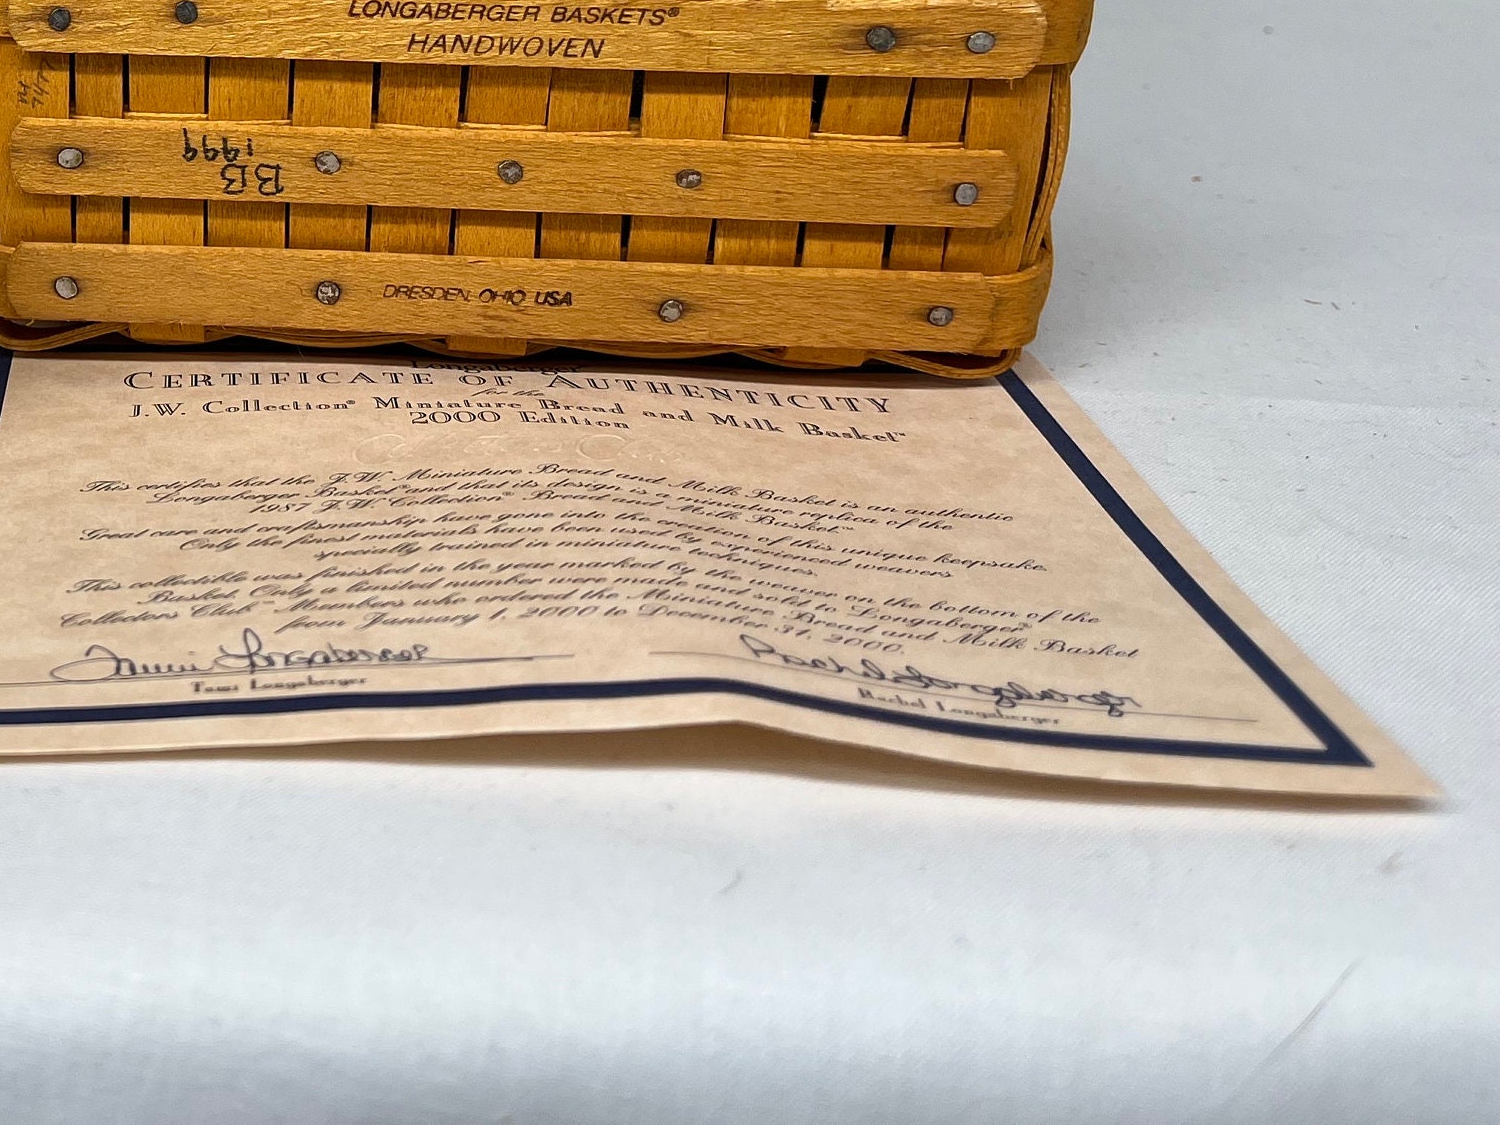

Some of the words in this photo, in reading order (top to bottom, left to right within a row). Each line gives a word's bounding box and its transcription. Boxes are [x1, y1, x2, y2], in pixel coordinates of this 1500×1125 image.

[348, 0, 541, 22] LONGABERGER
[550, 6, 680, 26] BASKETS®
[407, 33, 605, 59] HANDWOVEN
[181, 127, 254, 163] 1999
[478, 288, 527, 305] OHIO
[535, 290, 573, 306] USA
[123, 371, 435, 390] CERTIFICATE
[458, 374, 513, 387] OF
[547, 373, 891, 415] AUTHENTICITY
[129, 402, 187, 418] J.W.
[202, 399, 356, 414] Collection®
[373, 396, 522, 410] Miniature
[538, 398, 624, 415] Bread
[642, 409, 695, 422] and
[706, 411, 784, 433] Milk
[409, 410, 501, 425] 2000
[519, 410, 630, 429] Edition
[79, 480, 129, 492] This
[137, 478, 221, 492] certifies
[228, 476, 280, 487] that
[280, 475, 316, 486] the
[393, 468, 522, 481] Miniature
[528, 463, 616, 475] Bread
[615, 473, 666, 484] and
[668, 480, 742, 496] Milk
[745, 488, 837, 506] Basket
[840, 500, 861, 509] is
[866, 505, 899, 513] an
[904, 507, 1014, 521] authentic
[249, 503, 311, 514] 1987
[522, 489, 612, 501] Bread
[612, 497, 665, 507] and
[665, 504, 742, 520] Milk
[405, 481, 458, 493] and
[458, 479, 509, 490] that
[512, 479, 538, 488] its
[547, 478, 622, 491] design
[677, 496, 794, 515] miniature
[799, 511, 879, 525] replica
[886, 517, 921, 529] of
[917, 520, 953, 531] the
[79, 529, 149, 541] Great
[150, 529, 198, 537] care
[203, 523, 260, 535] and
[256, 515, 426, 535] craftsmanship
[434, 511, 491, 523] have
[491, 512, 553, 523] gone
[560, 510, 606, 519] into
[614, 512, 651, 522] the
[657, 519, 749, 539] creation
[757, 535, 793, 547] of
[790, 539, 835, 551] this
[842, 548, 929, 562] unique
[180, 537, 241, 553] Only
[246, 535, 284, 547] the
[282, 532, 360, 549] finest
[360, 523, 477, 541] materials
[484, 522, 544, 534] have
[550, 521, 602, 533] been
[611, 528, 673, 537] used
[674, 531, 702, 544] by
[710, 540, 853, 567] experienced
[854, 562, 953, 578] weavers
[313, 541, 422, 562] specially
[429, 537, 525, 552] trained
[525, 539, 549, 548] in
[556, 540, 682, 552] miniature
[66, 578, 121, 595] This
[129, 570, 248, 590] collectible
[252, 572, 302, 581] was
[303, 562, 421, 583] finished
[420, 563, 444, 573] in
[452, 558, 490, 572] the
[490, 562, 555, 574] year
[558, 557, 666, 570] marked
[667, 561, 696, 576] by
[704, 569, 742, 581] the
[748, 578, 838, 597] weaver
[844, 594, 876, 604] on
[882, 597, 921, 610] the
[928, 600, 1020, 619] bottom
[1026, 609, 1064, 623] of
[1060, 612, 1101, 624] the
[249, 582, 314, 600] Only
[346, 577, 446, 593] limited
[443, 572, 543, 588] number
[548, 576, 607, 585] were
[613, 576, 688, 586] made
[694, 582, 752, 595] and
[752, 592, 813, 608] sold
[814, 602, 837, 613] to
[60, 609, 179, 627] Collectors
[272, 595, 405, 615] Members
[413, 591, 467, 606] who
[475, 589, 579, 604] ordered
[580, 586, 620, 600] the
[626, 587, 775, 616] Miniature
[782, 609, 879, 633] Bread
[881, 630, 939, 642] and
[942, 632, 1028, 651] Milk
[1032, 639, 1140, 659] Basket
[273, 615, 345, 635] from
[354, 611, 480, 631] January
[637, 602, 769, 629] December
